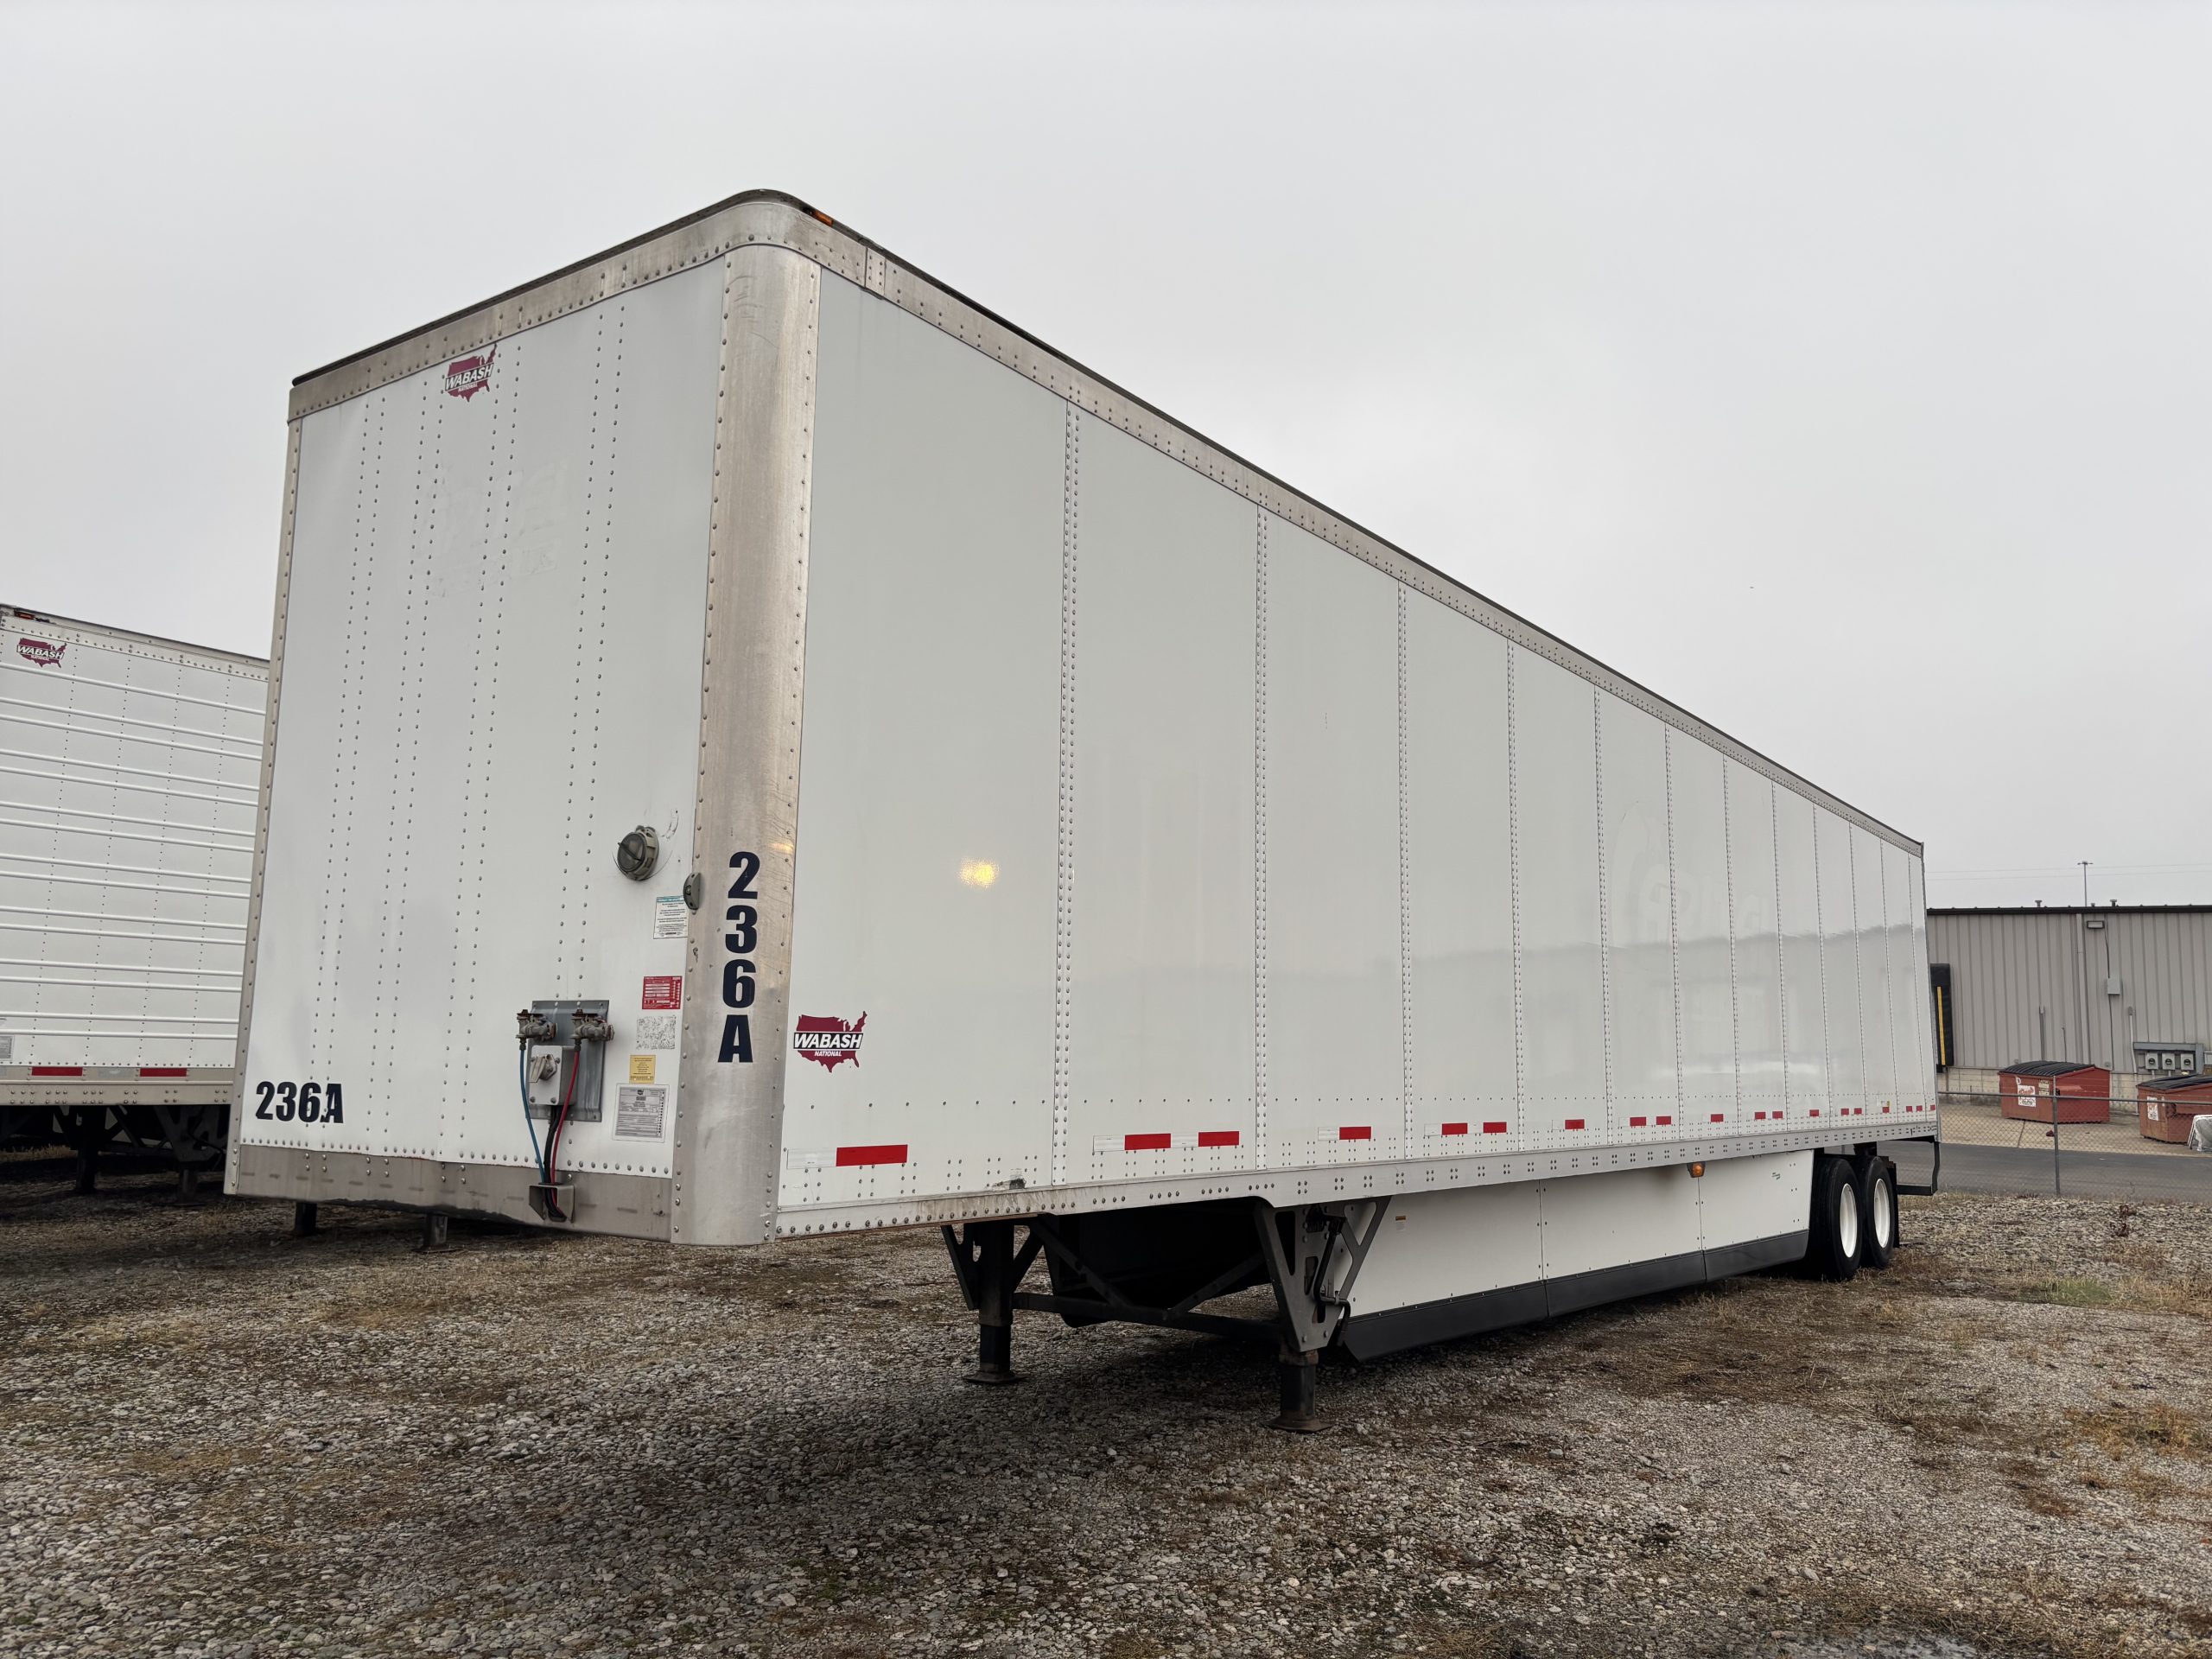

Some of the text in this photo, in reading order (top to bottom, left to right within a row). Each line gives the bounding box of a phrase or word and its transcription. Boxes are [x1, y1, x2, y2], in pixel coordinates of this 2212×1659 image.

[446, 364, 493, 390] WABASH
[17, 645, 64, 659] WABASH
[718, 851, 760, 1063] 236A
[794, 1033, 862, 1048] WABASH
[255, 1081, 344, 1123] 236A
